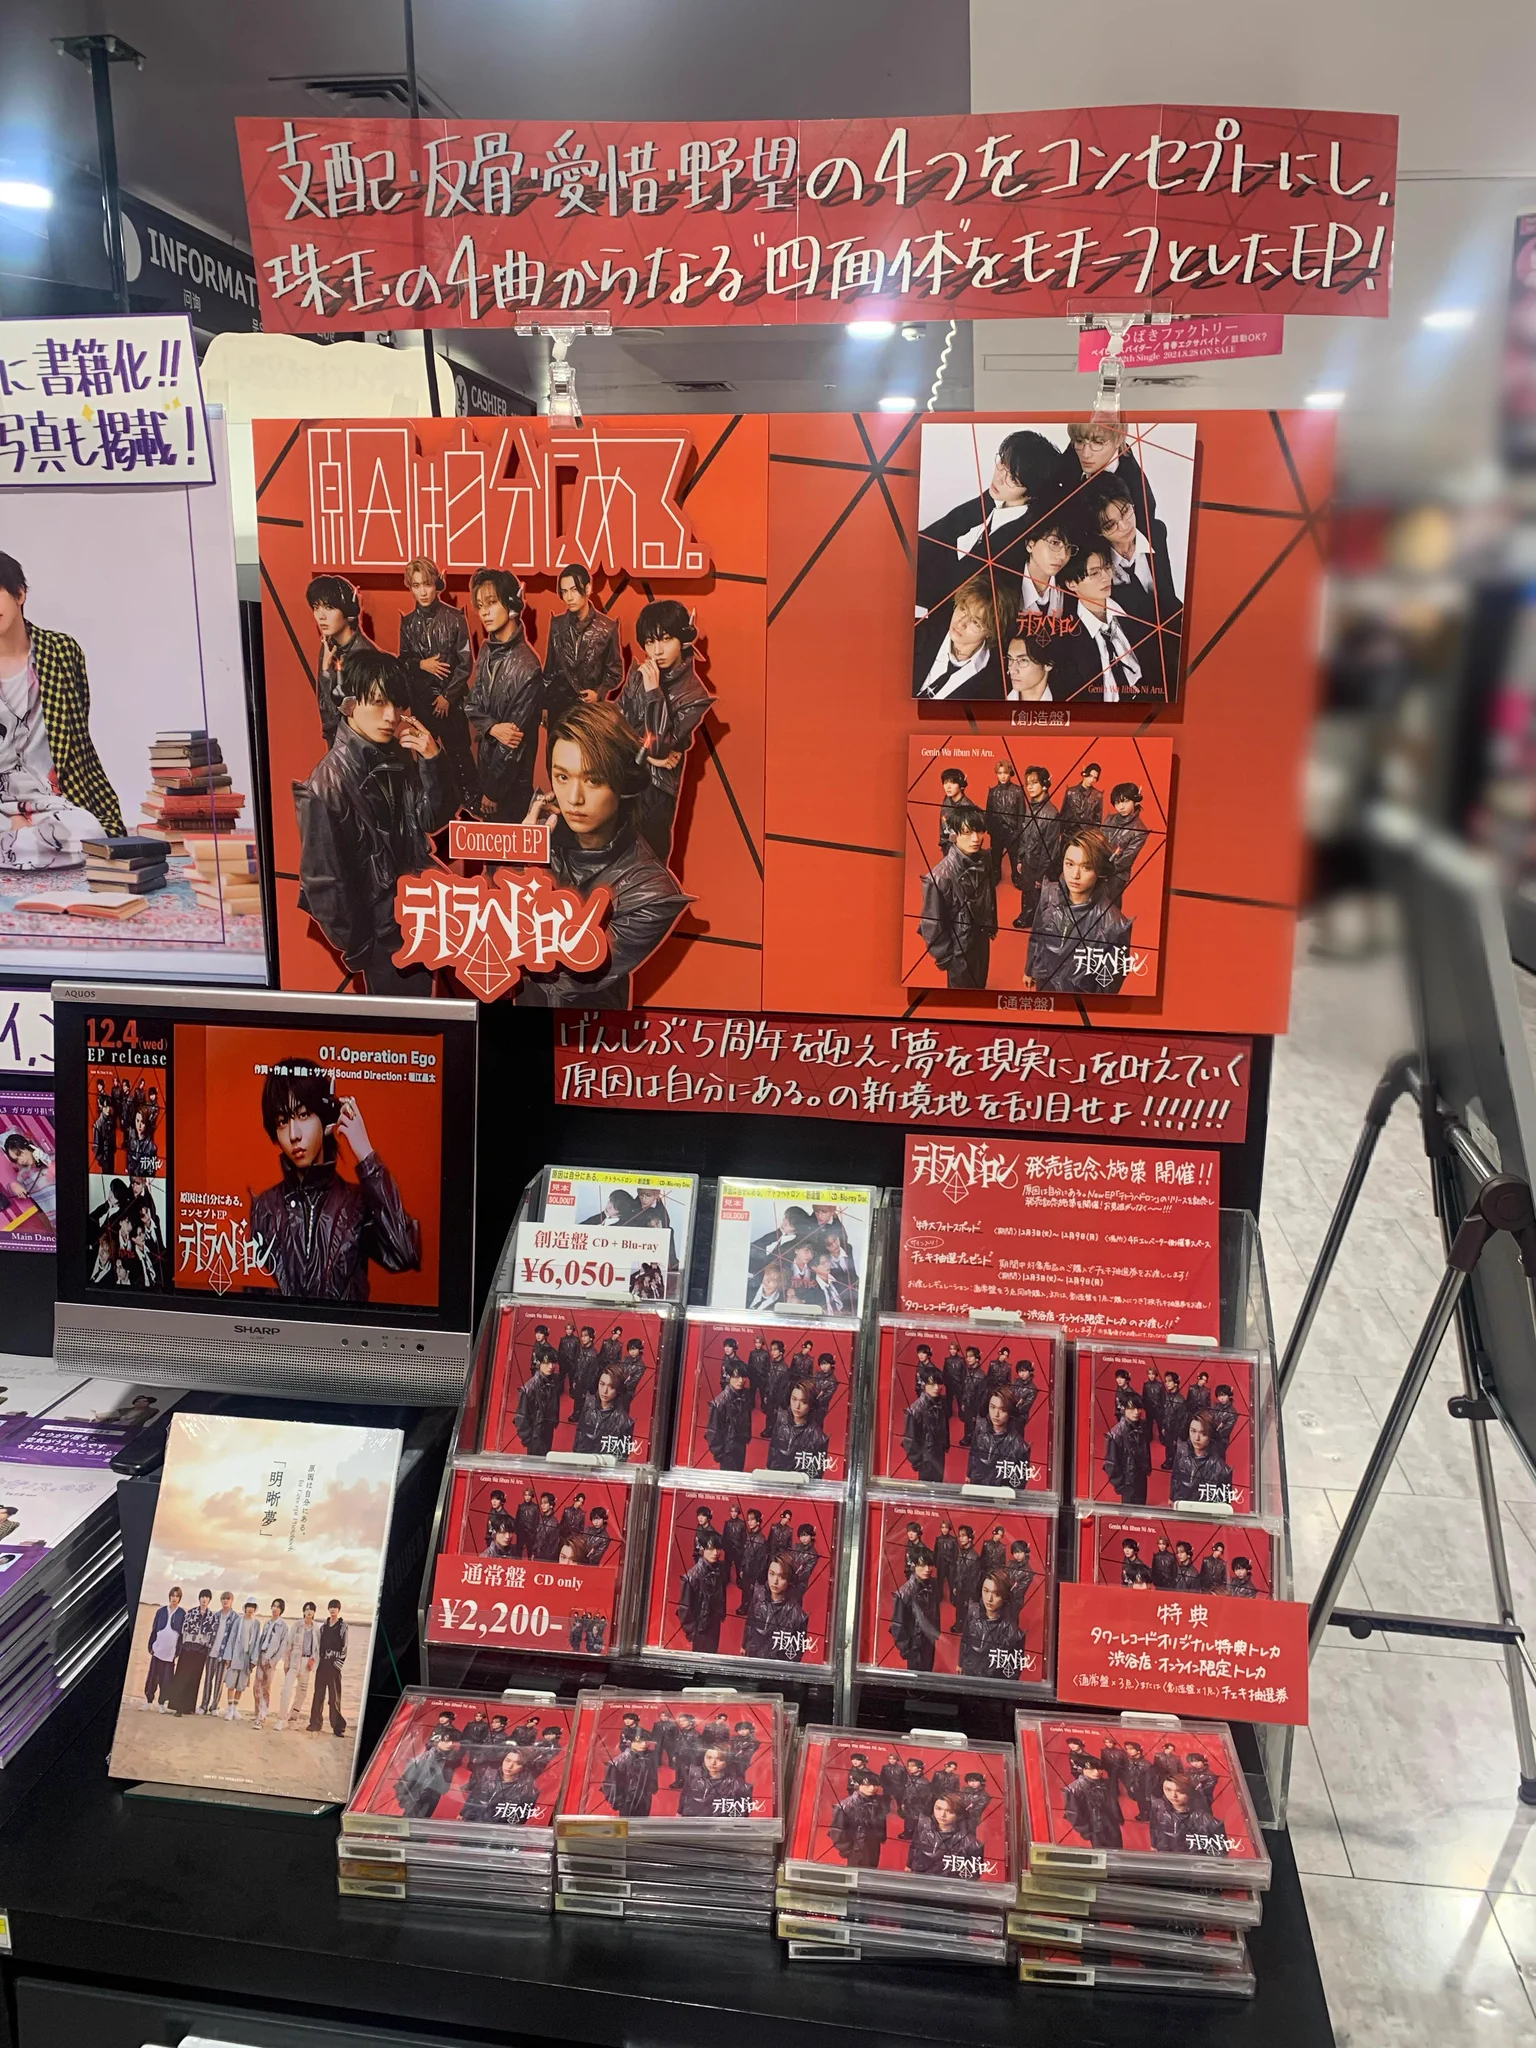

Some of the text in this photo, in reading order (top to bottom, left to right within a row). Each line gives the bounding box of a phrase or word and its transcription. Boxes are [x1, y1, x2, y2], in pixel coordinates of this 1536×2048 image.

[147, 227, 262, 310] INFORMAT
[1136, 353, 1159, 362] Single
[1163, 350, 1199, 359] 2024.8.28
[1199, 348, 1213, 356] ON
[1214, 346, 1236, 355] SALE
[470, 385, 508, 417] CASHIER
[1087, 684, 1108, 694] Genin
[1140, 684, 1150, 695] Ni
[1150, 685, 1165, 695] Aru.
[921, 747, 995, 758] Genin Wa Jibun Ni Aru.
[455, 825, 543, 859] Concept EP
[64, 989, 96, 998] AQUOS
[88, 1048, 167, 1066] EP release
[319, 1046, 436, 1066] 01.Operation Ego
[551, 1182, 570, 1192] 見本
[549, 1197, 575, 1206] SOLDOUT
[724, 1199, 742, 1208] 見本
[11, 1233, 56, 1242] Main Danc
[533, 1230, 588, 1250] 創造盤
[592, 1237, 609, 1248] CD
[622, 1238, 659, 1252] Blu-ray
[234, 1325, 281, 1336] SHARP
[260, 1460, 287, 1537] 「明晰夢」
[461, 1562, 584, 1592] 通常盤 CD only
